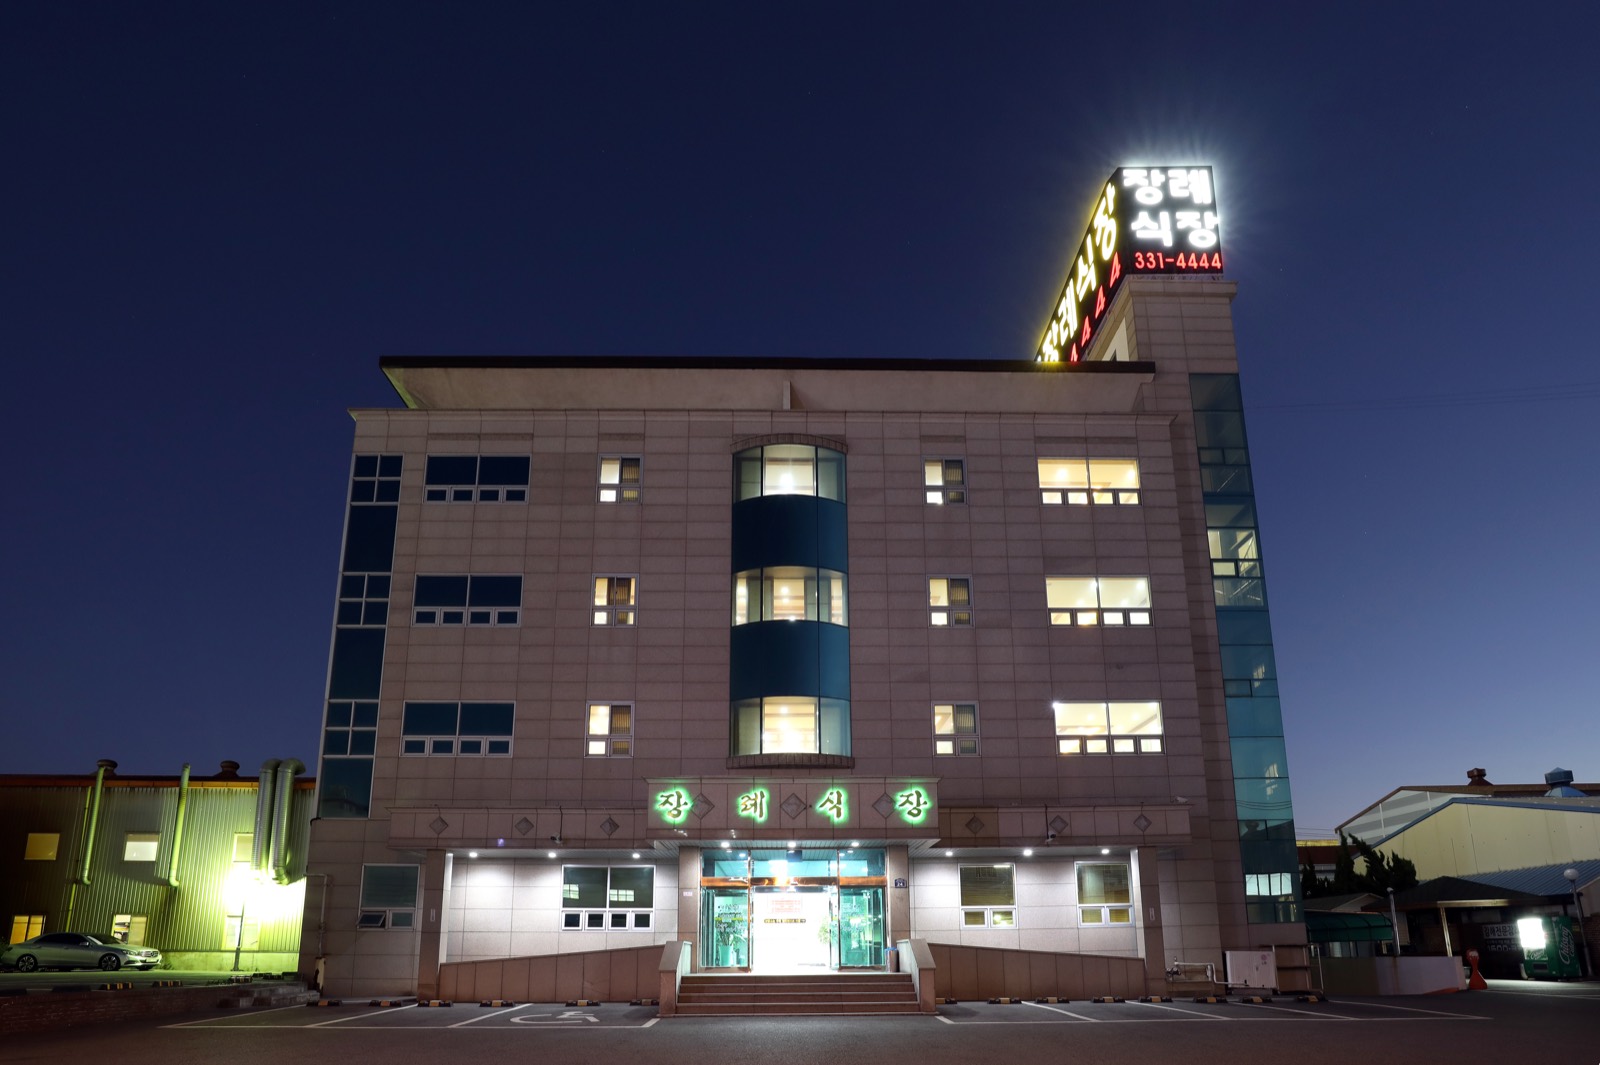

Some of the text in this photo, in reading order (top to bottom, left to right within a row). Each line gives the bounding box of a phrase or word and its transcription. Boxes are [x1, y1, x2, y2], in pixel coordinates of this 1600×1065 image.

[1123, 169, 1213, 204] 장례
[1131, 211, 1220, 248] 식장
[1135, 252, 1221, 269] 331-4444
